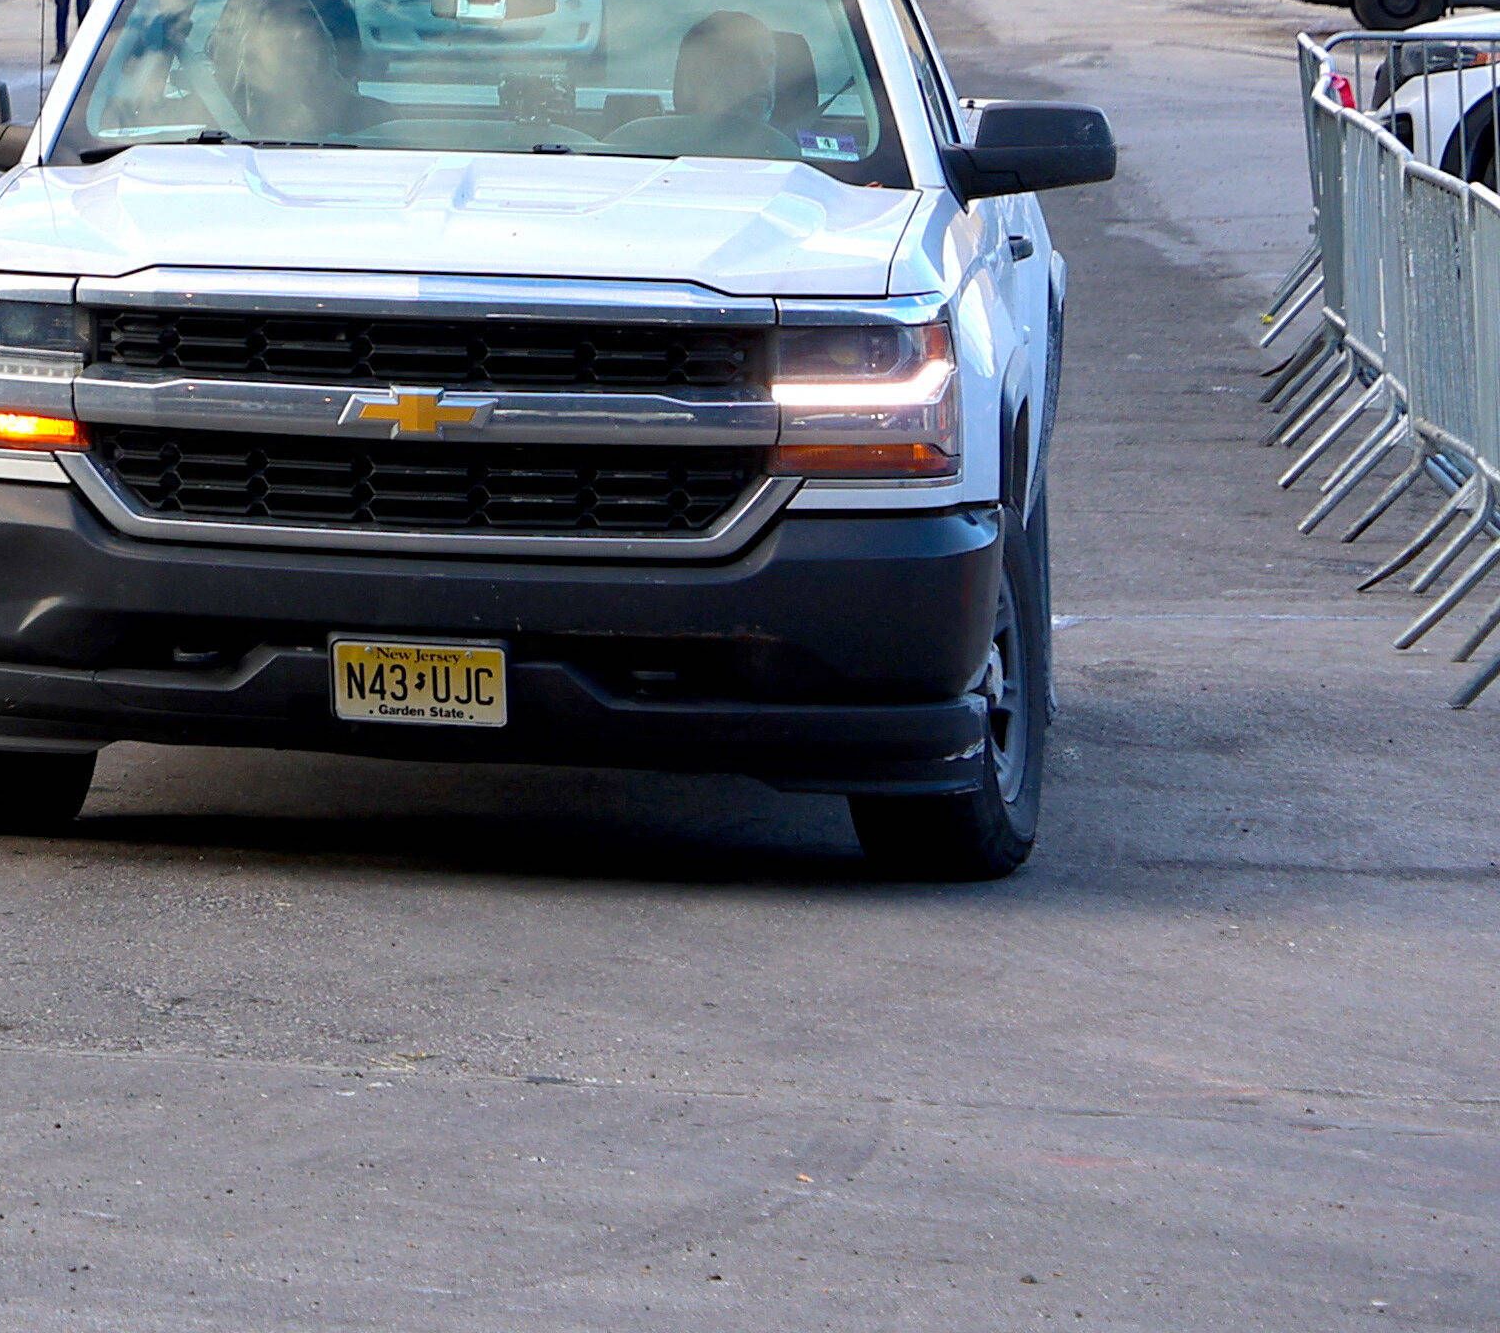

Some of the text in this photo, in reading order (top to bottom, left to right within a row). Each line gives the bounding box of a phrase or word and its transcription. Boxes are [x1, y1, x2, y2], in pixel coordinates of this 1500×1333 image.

[376, 647, 461, 665] New Jersey
[346, 662, 494, 705] N43 UJC
[378, 704, 465, 720] Garden State
